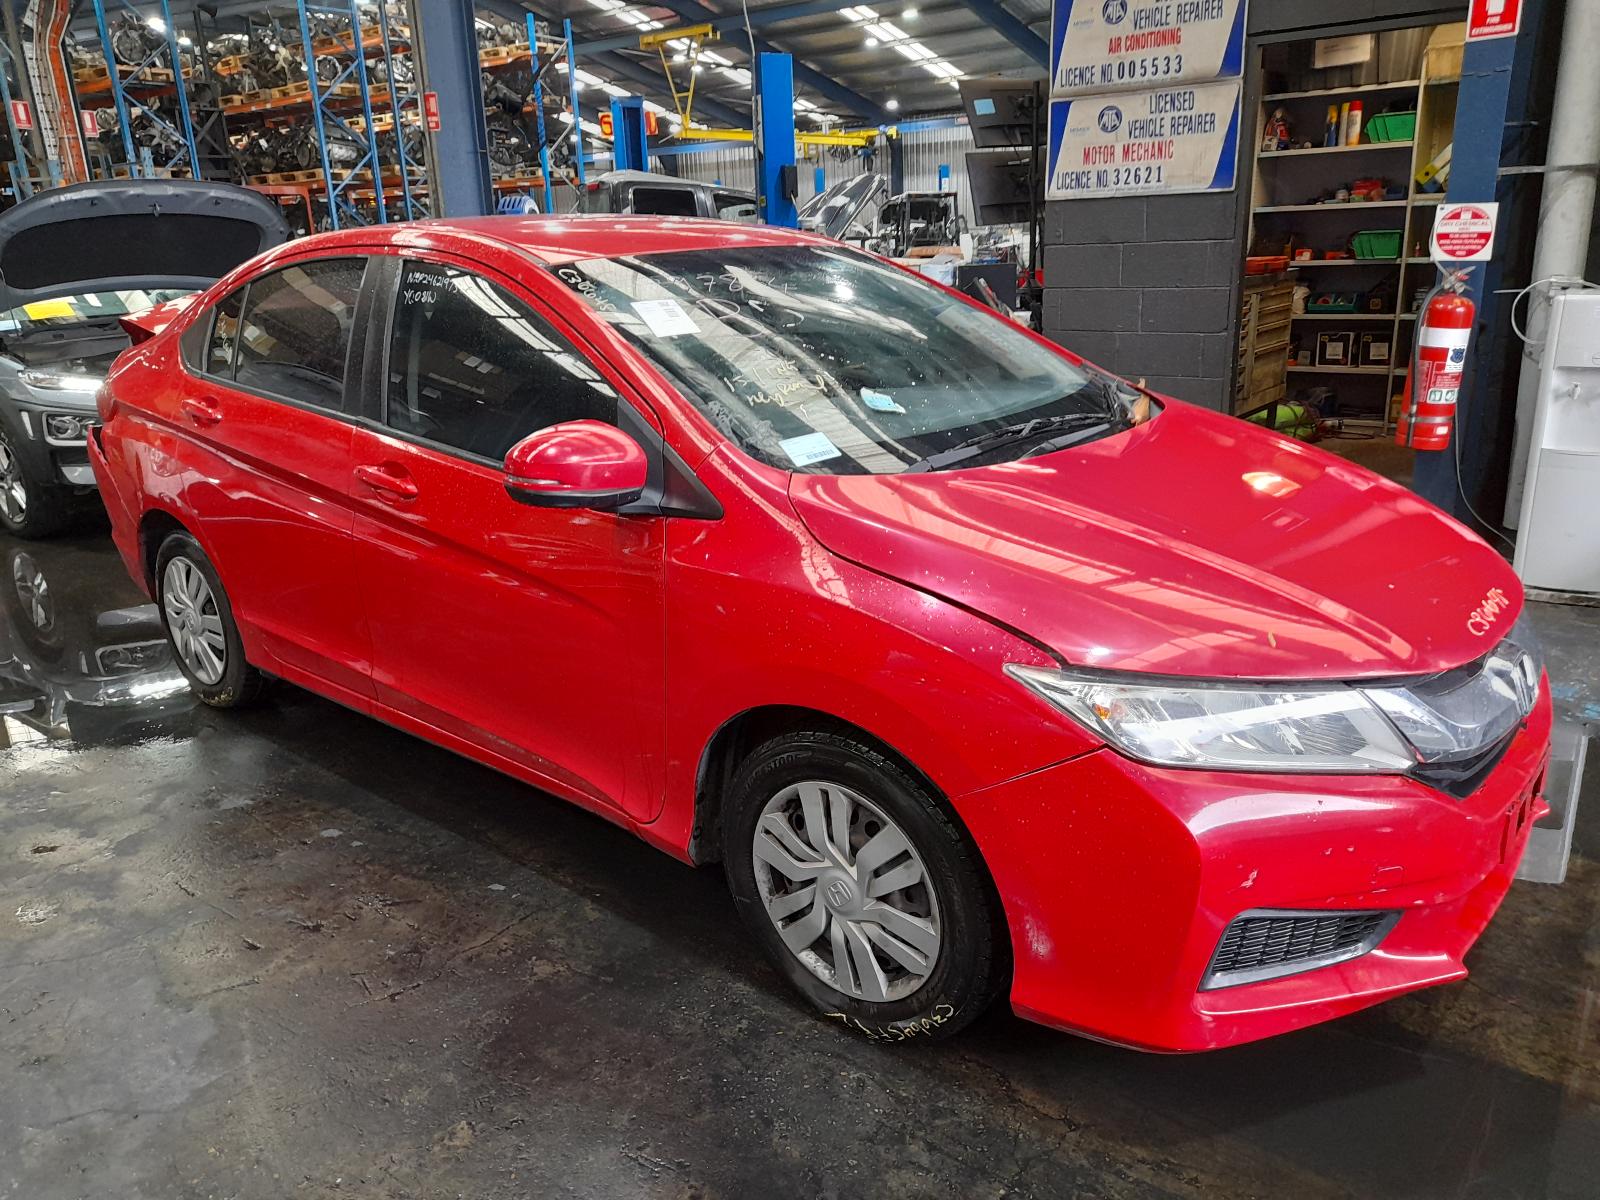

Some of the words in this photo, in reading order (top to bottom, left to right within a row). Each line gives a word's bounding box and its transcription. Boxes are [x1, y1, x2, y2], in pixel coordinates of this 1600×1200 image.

[1133, 7, 1171, 31] VEHICLE
[1176, 1, 1224, 24] REPAIRER
[1108, 37, 1122, 55] AIR
[1124, 27, 1182, 53] CONDITIONING
[1060, 64, 1096, 88] LICENCE
[1100, 63, 1114, 84] NO.
[1117, 54, 1183, 80] 005533
[1149, 90, 1195, 114] LICENSED
[1128, 116, 1165, 139] VEHICLE
[1170, 112, 1216, 137] REPAIRER
[1082, 145, 1116, 166] MOTOR
[1121, 139, 1175, 163] MECHANIC
[1056, 169, 1092, 191] LICENCE
[1096, 169, 1109, 189] NO.
[1112, 165, 1163, 186] 32621
